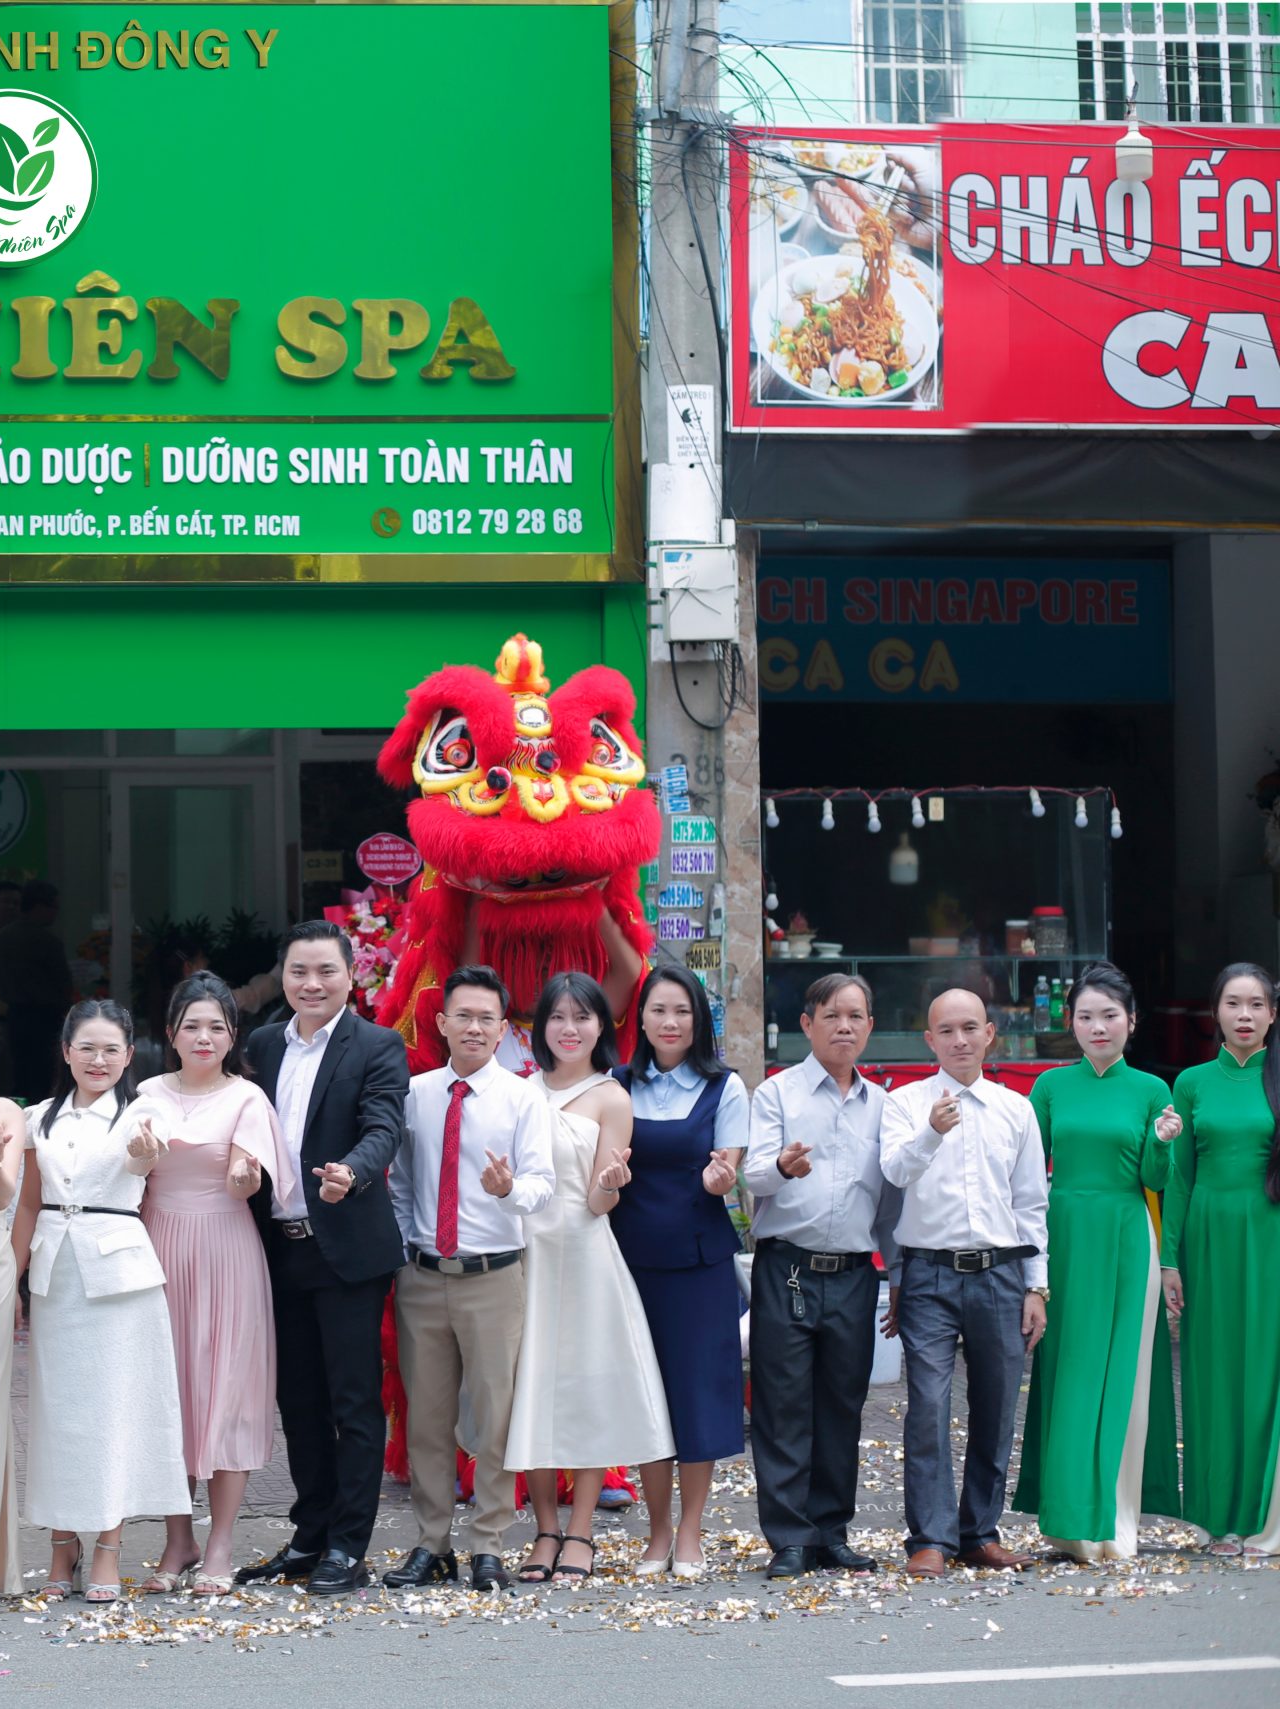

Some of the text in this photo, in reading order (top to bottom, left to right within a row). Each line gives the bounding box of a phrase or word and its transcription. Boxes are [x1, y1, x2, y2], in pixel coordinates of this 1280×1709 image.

[75, 19, 231, 70] ĐÔNG
[245, 28, 279, 69] Y
[46, 203, 76, 241] Spa
[947, 148, 1280, 267] CHÁO ẾC
[275, 296, 517, 382] SPA
[41, 443, 133, 495] DƯỢC
[162, 436, 278, 484] DƯỠNG
[288, 447, 368, 484] SINH
[378, 439, 470, 484] TOÀN
[480, 438, 573, 484] THÂN
[29, 509, 102, 539] PHƯỚC,
[129, 506, 170, 536] BẾN
[175, 509, 217, 538] CÁT,
[221, 514, 249, 536] TP.
[254, 515, 301, 536] HCM
[411, 507, 583, 535] 0812 79 28 68
[843, 577, 1140, 626] SINGAPORE
[757, 637, 960, 694] CA CA
